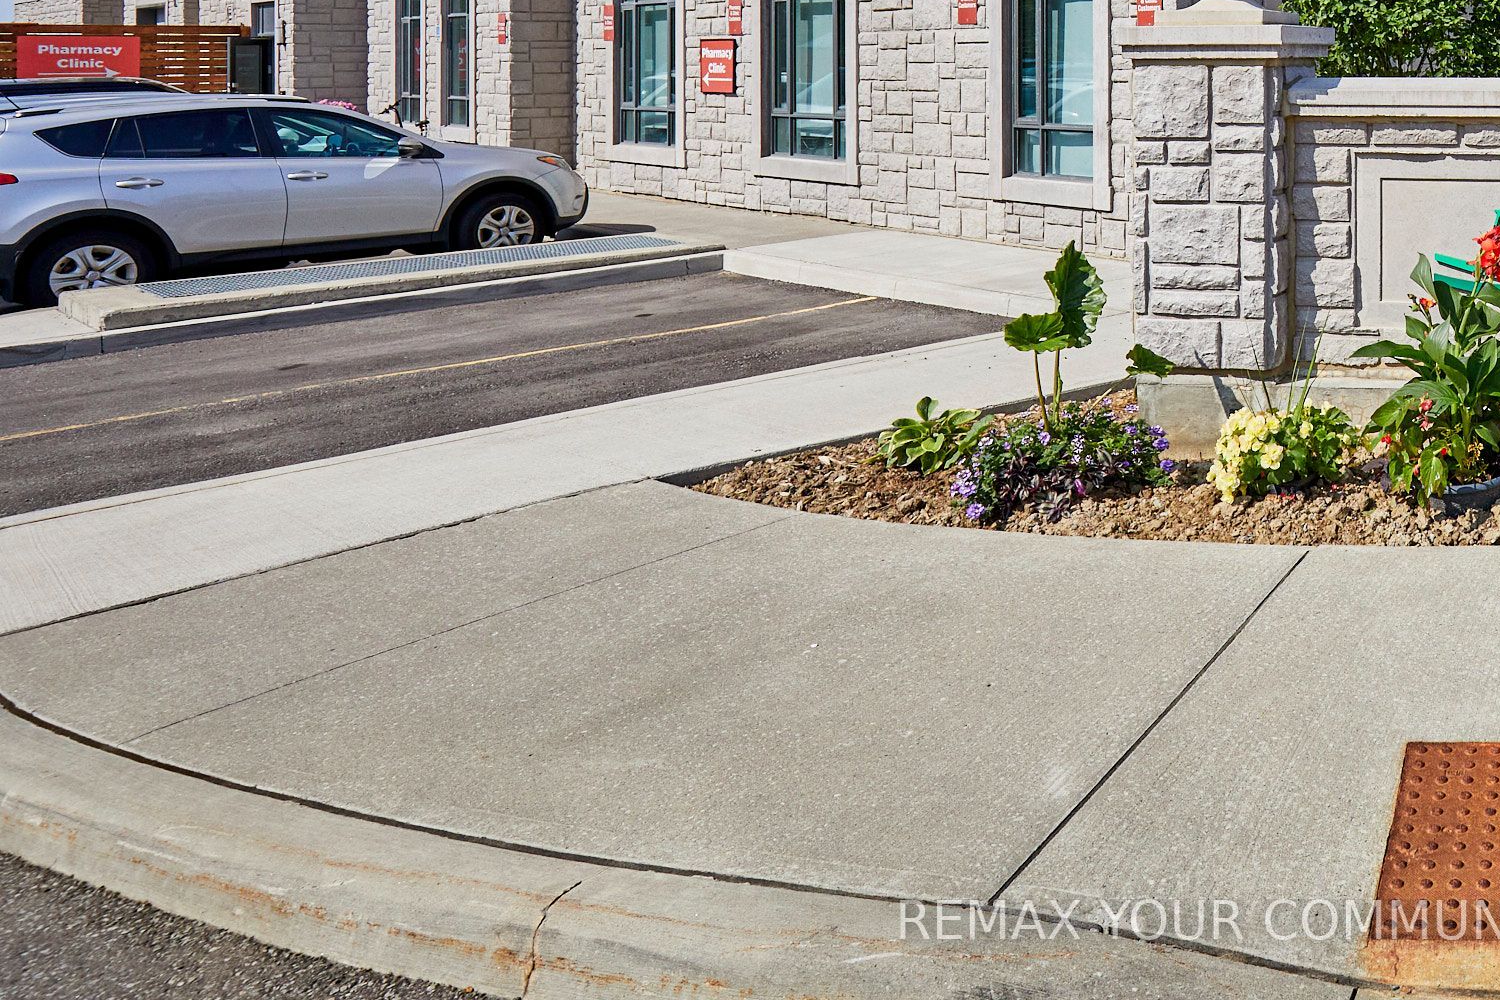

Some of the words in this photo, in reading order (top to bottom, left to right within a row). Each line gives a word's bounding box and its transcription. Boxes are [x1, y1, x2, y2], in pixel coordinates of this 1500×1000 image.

[38, 44, 122, 56] Pharmacy
[702, 47, 733, 60] Pharmacy
[56, 58, 104, 69] Clinic
[708, 62, 726, 74] Clinic
